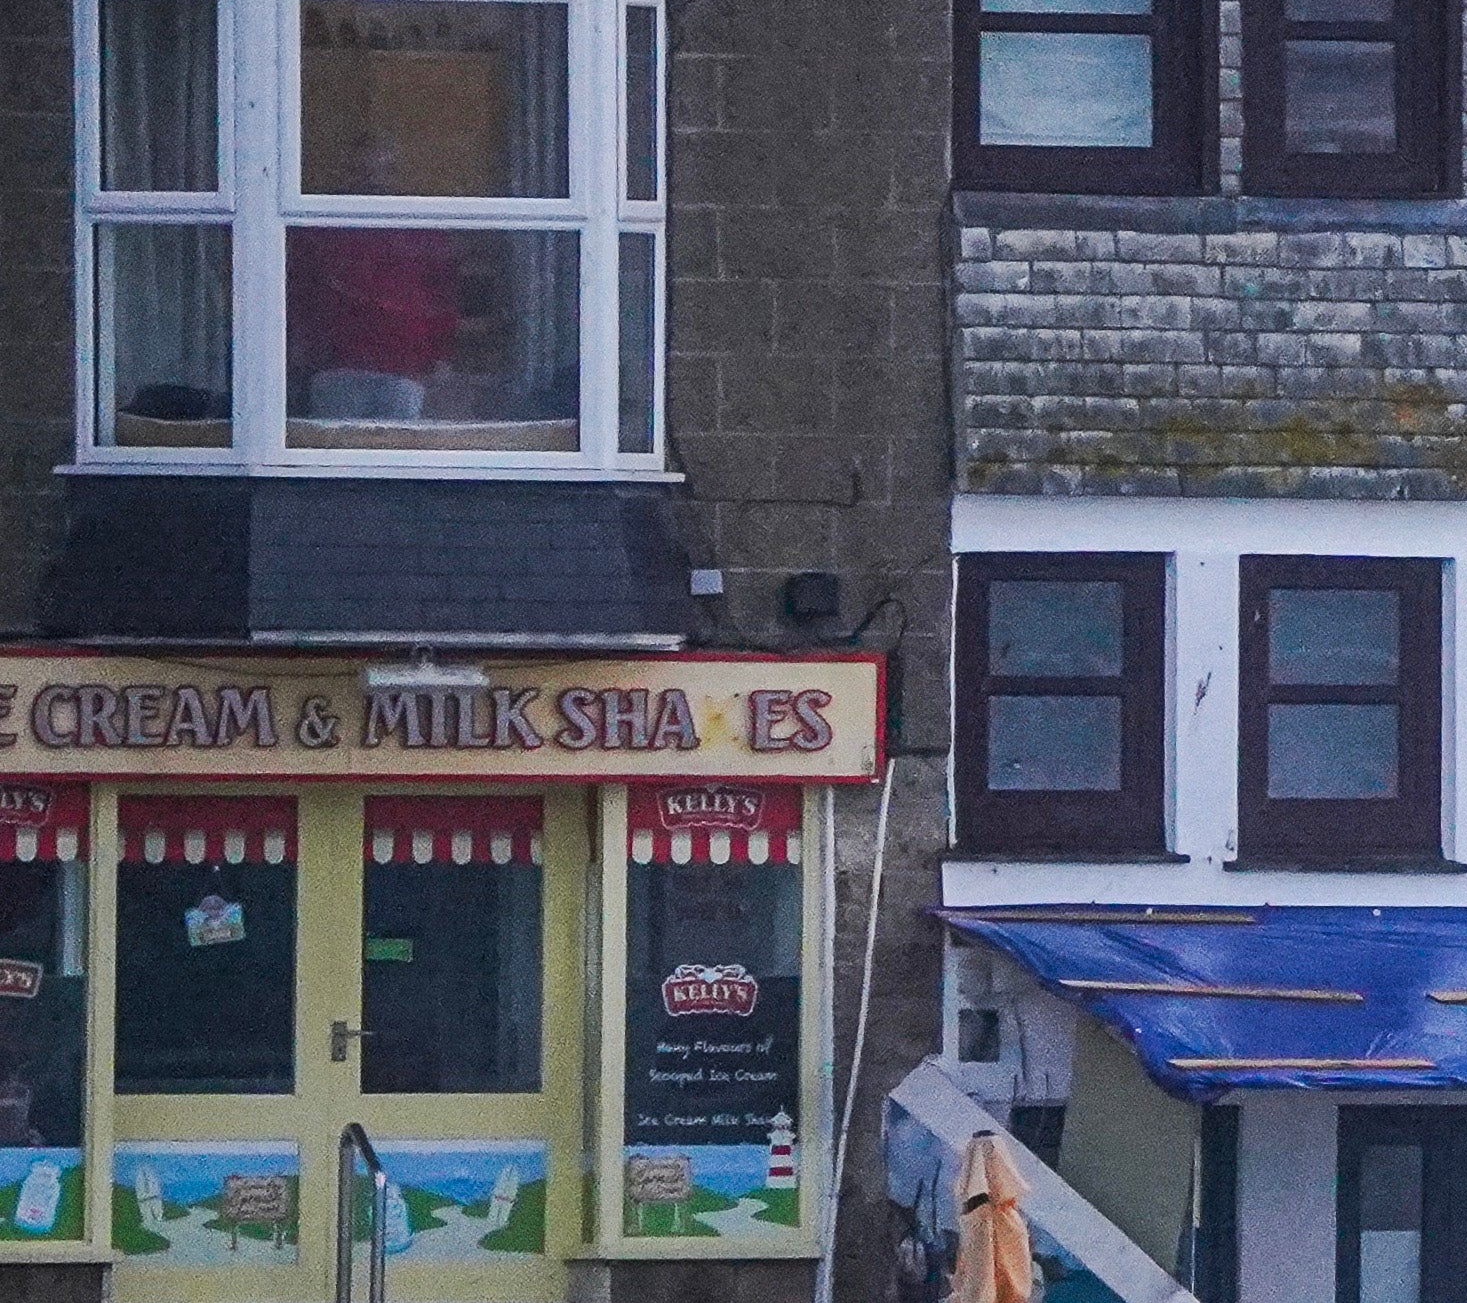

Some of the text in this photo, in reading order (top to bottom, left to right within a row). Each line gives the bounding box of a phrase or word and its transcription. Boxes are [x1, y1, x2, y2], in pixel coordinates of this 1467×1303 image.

[30, 684, 278, 748] CREAM
[300, 698, 340, 748] &
[362, 687, 544, 751] MILK
[558, 688, 832, 753] SHAES
[666, 793, 758, 818] KELLY'S
[673, 982, 748, 1003] KELLY'S
